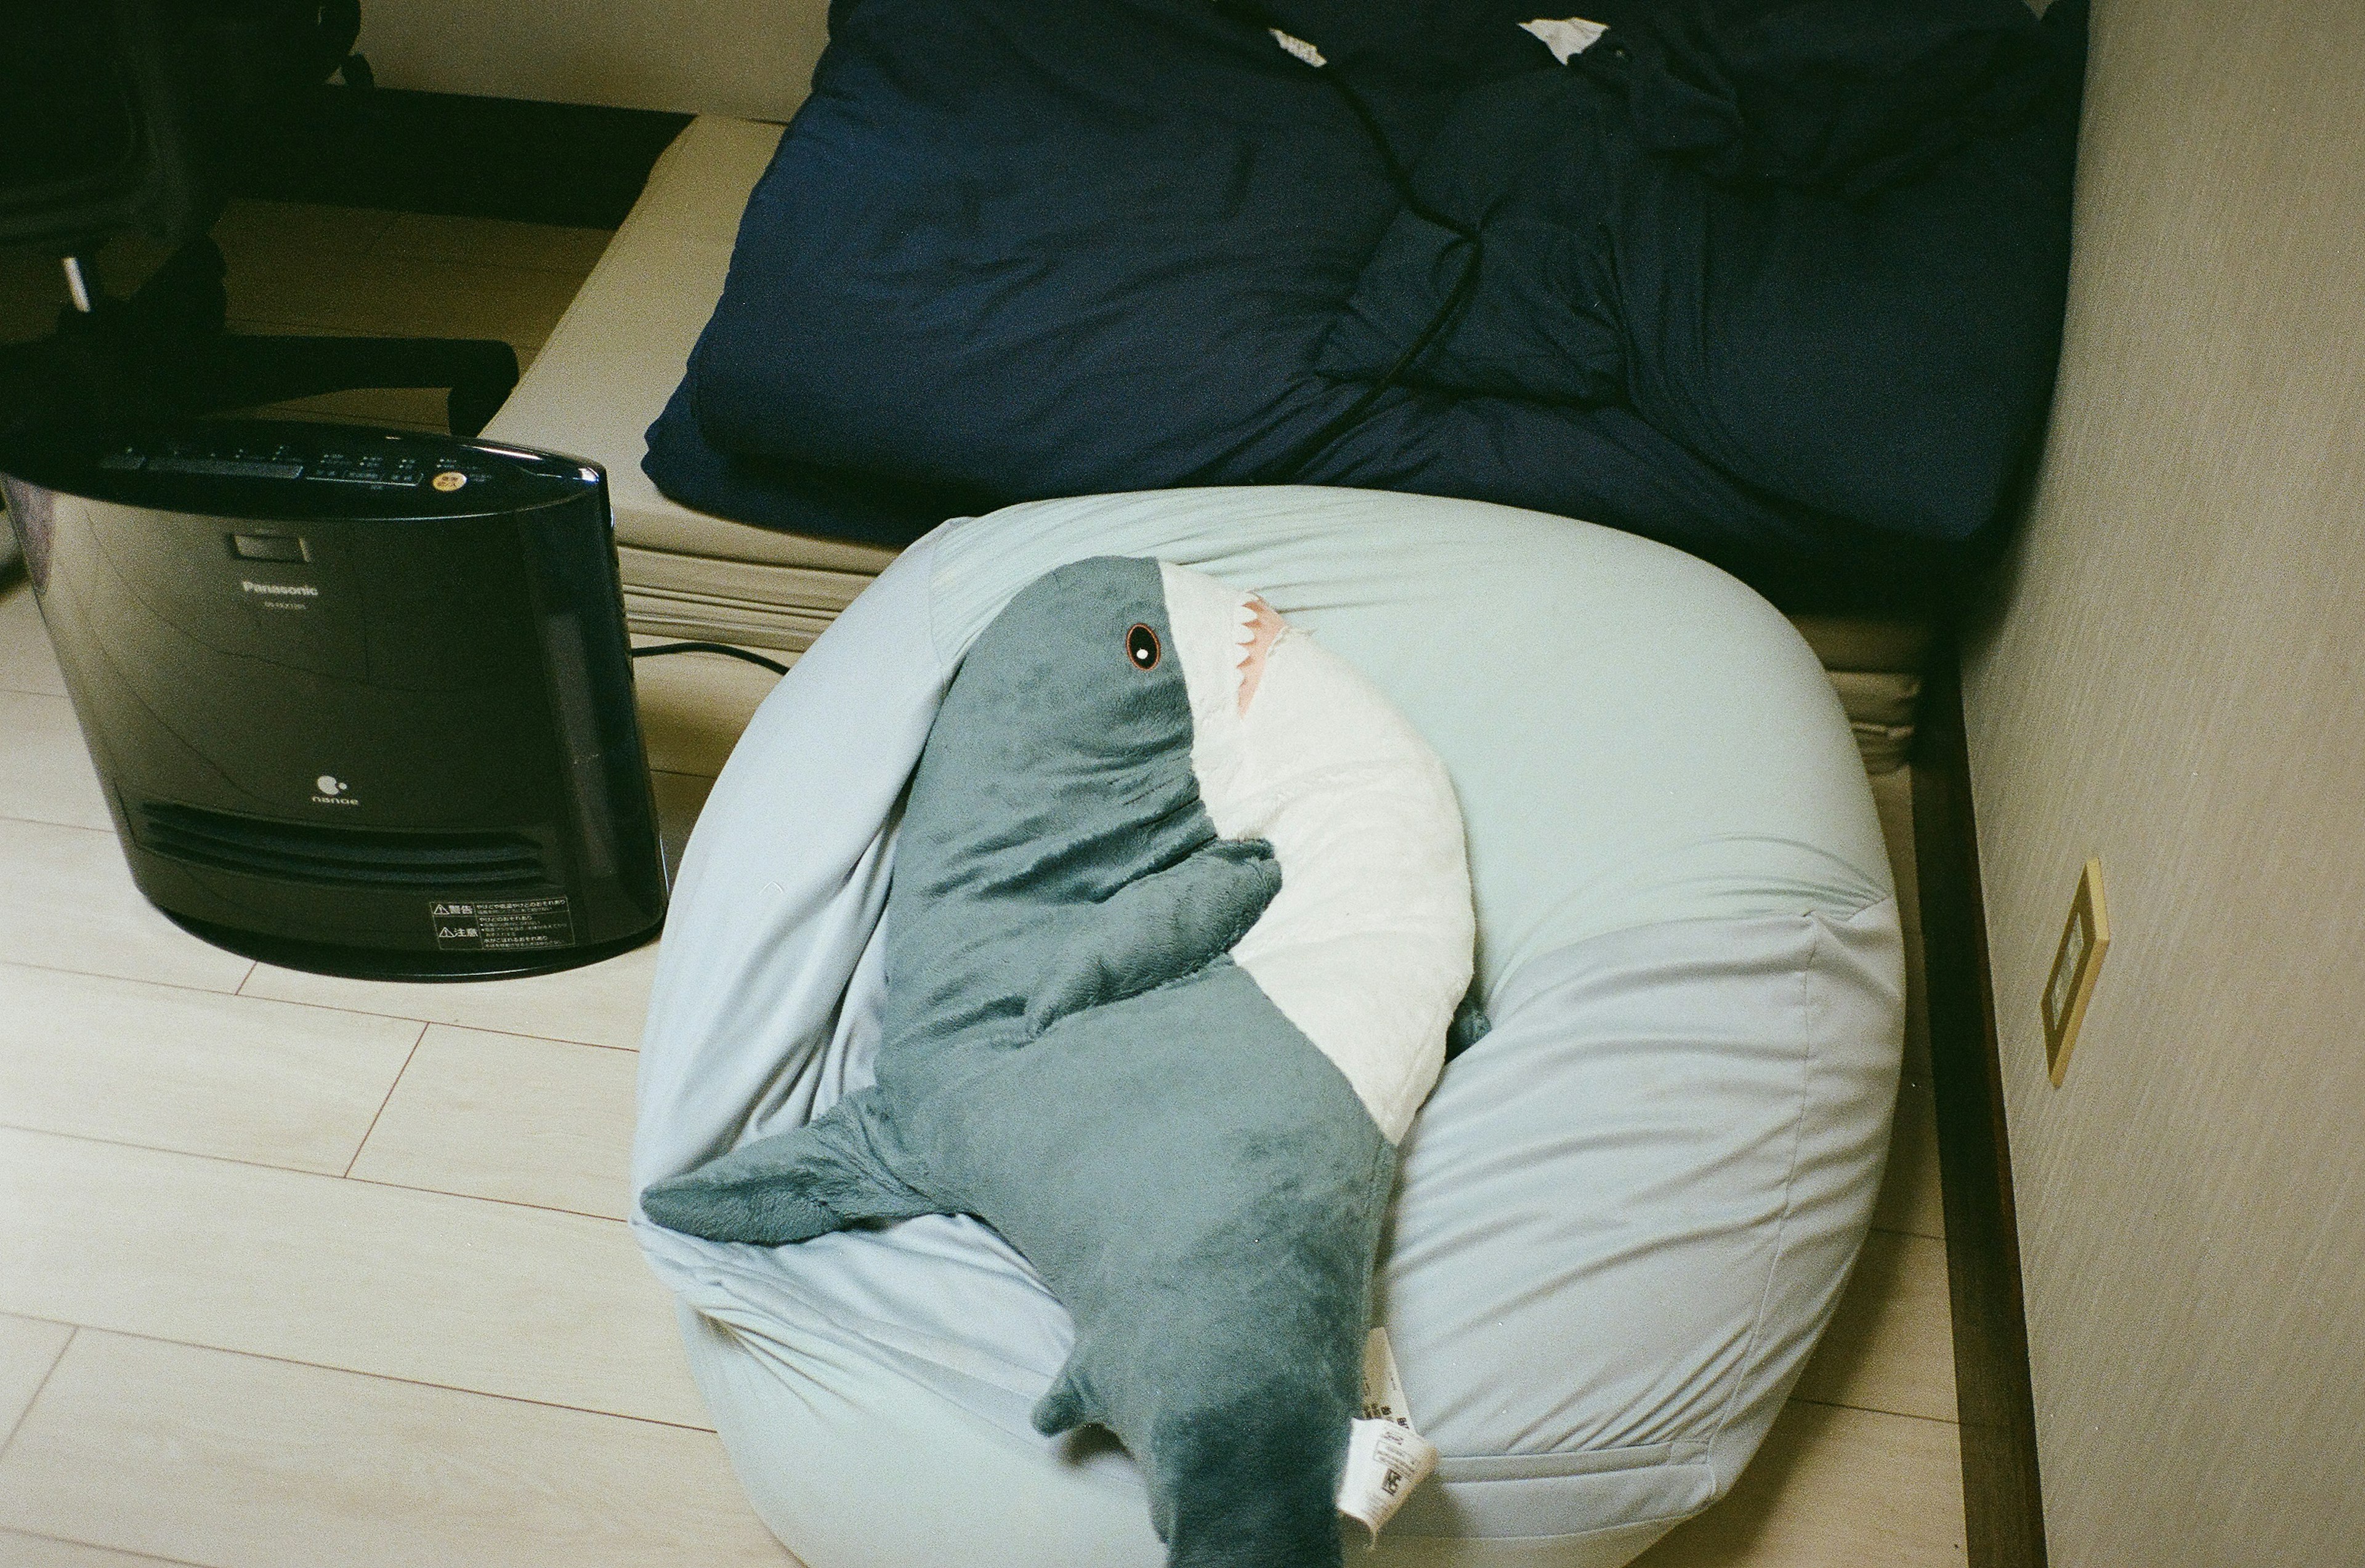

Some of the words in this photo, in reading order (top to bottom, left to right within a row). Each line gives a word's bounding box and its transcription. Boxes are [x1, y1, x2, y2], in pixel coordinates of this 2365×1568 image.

[242, 581, 319, 596] Panasonic
[312, 796, 359, 806] nanoe
[448, 904, 473, 915] 警告
[454, 927, 479, 937] 注意
